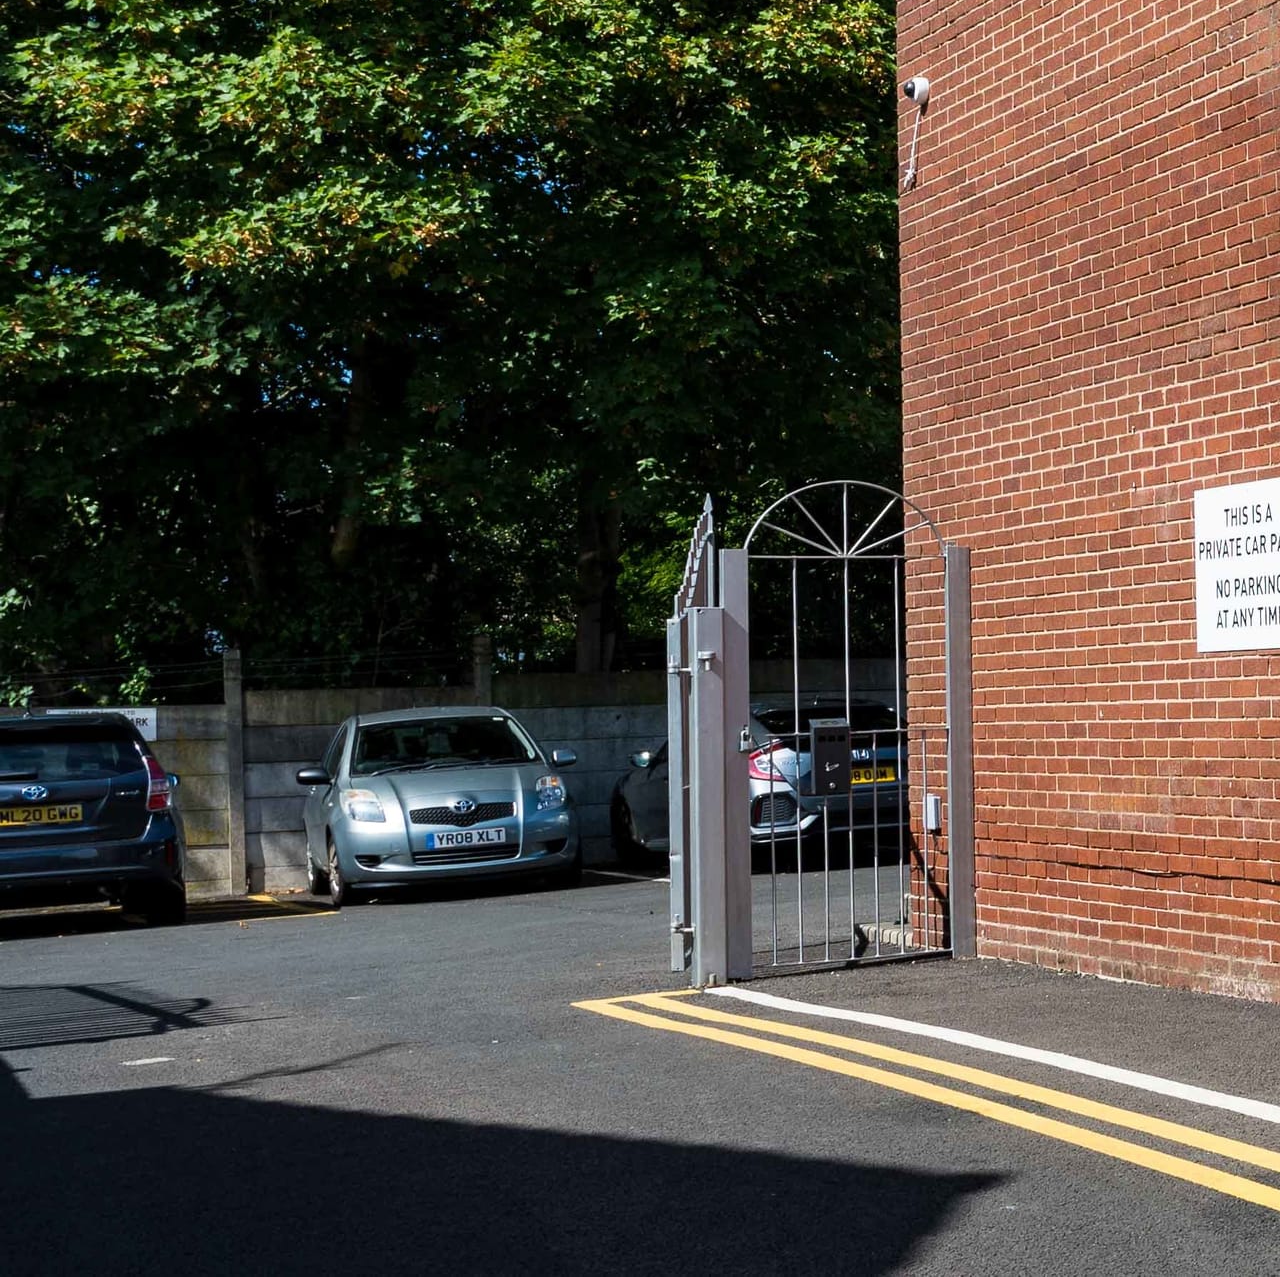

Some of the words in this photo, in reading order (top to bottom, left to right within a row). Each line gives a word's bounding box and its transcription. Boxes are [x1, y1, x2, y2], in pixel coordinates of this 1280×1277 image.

[1224, 506, 1248, 527] THIS
[1252, 504, 1262, 523] IS
[1265, 503, 1273, 522] A
[1199, 537, 1242, 560] PRIVATE
[1245, 534, 1266, 555] CAR
[1216, 579, 1230, 599] NO
[1217, 609, 1229, 629] AT
[1232, 608, 1255, 628] ANY
[437, 832, 473, 846] YR08
[477, 829, 503, 843] XLT
